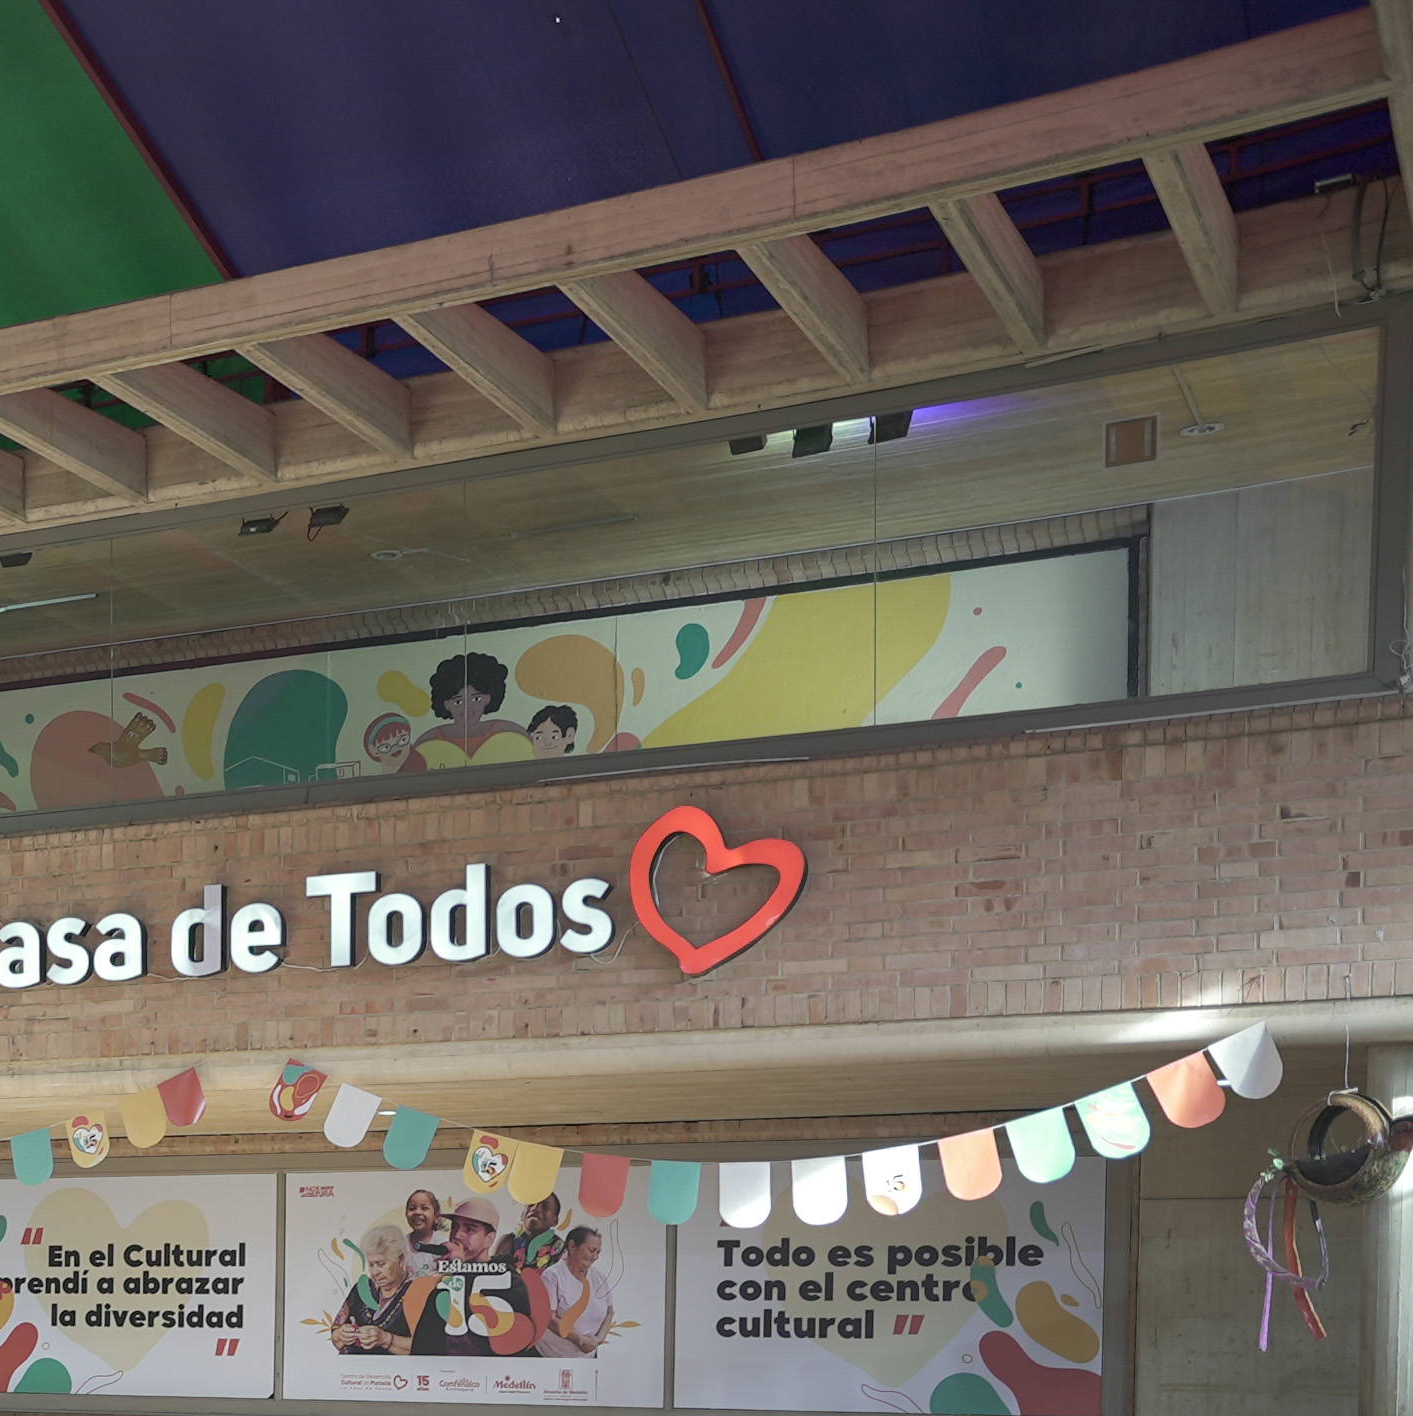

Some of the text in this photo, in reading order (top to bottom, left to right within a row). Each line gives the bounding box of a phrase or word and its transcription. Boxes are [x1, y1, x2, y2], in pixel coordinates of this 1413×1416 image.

[171, 883, 285, 977] de
[306, 862, 615, 968] Todos
[47, 1243, 247, 1269] En el Cultural
[438, 1258, 507, 1274] Estamos
[716, 1235, 1045, 1275] Todo es posible
[96, 1274, 115, 1295] a
[123, 1271, 246, 1296] abrazar
[448, 1277, 464, 1290] de
[716, 1272, 993, 1304] con el centro
[50, 1302, 245, 1330] la diversidad
[436, 1271, 516, 1337] 15
[716, 1309, 875, 1339] cultural
[416, 1375, 430, 1387] 15
[493, 1379, 537, 1390] Medellín
